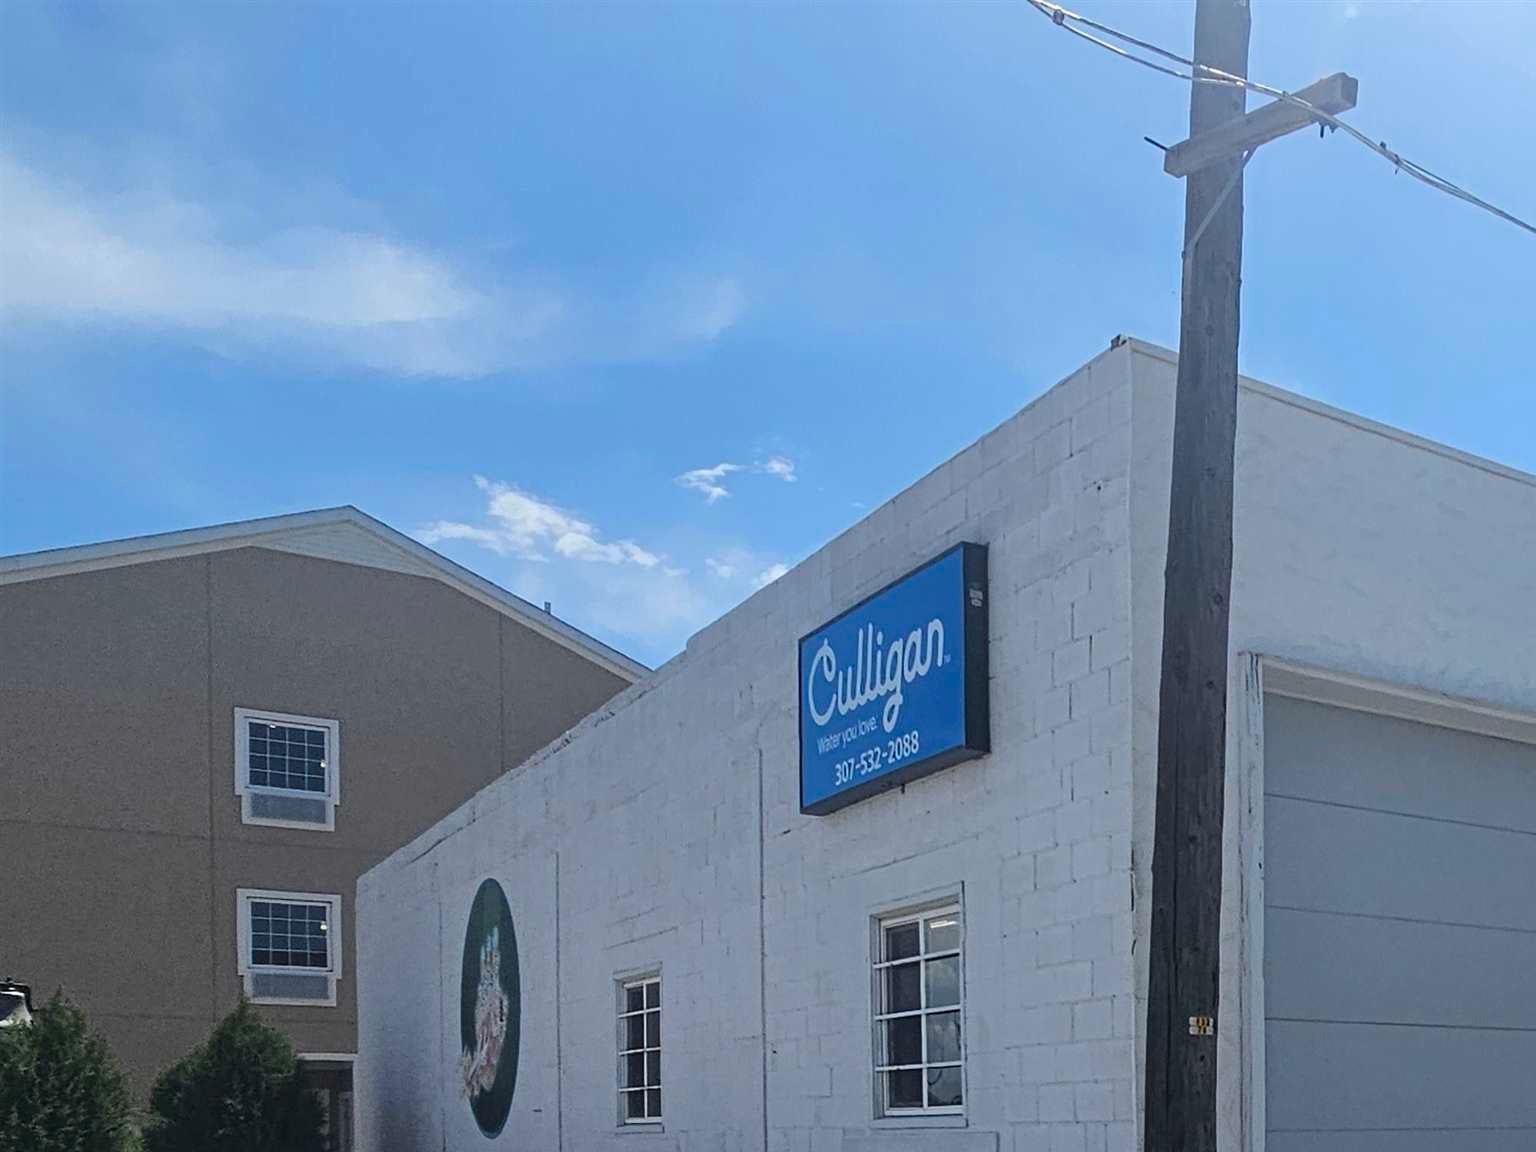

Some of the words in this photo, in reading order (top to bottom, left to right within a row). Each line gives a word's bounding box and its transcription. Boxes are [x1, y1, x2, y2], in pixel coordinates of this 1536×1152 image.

[808, 618, 944, 733] Culligan
[834, 730, 920, 787] 307-532-2088
[841, 726, 858, 749] you
